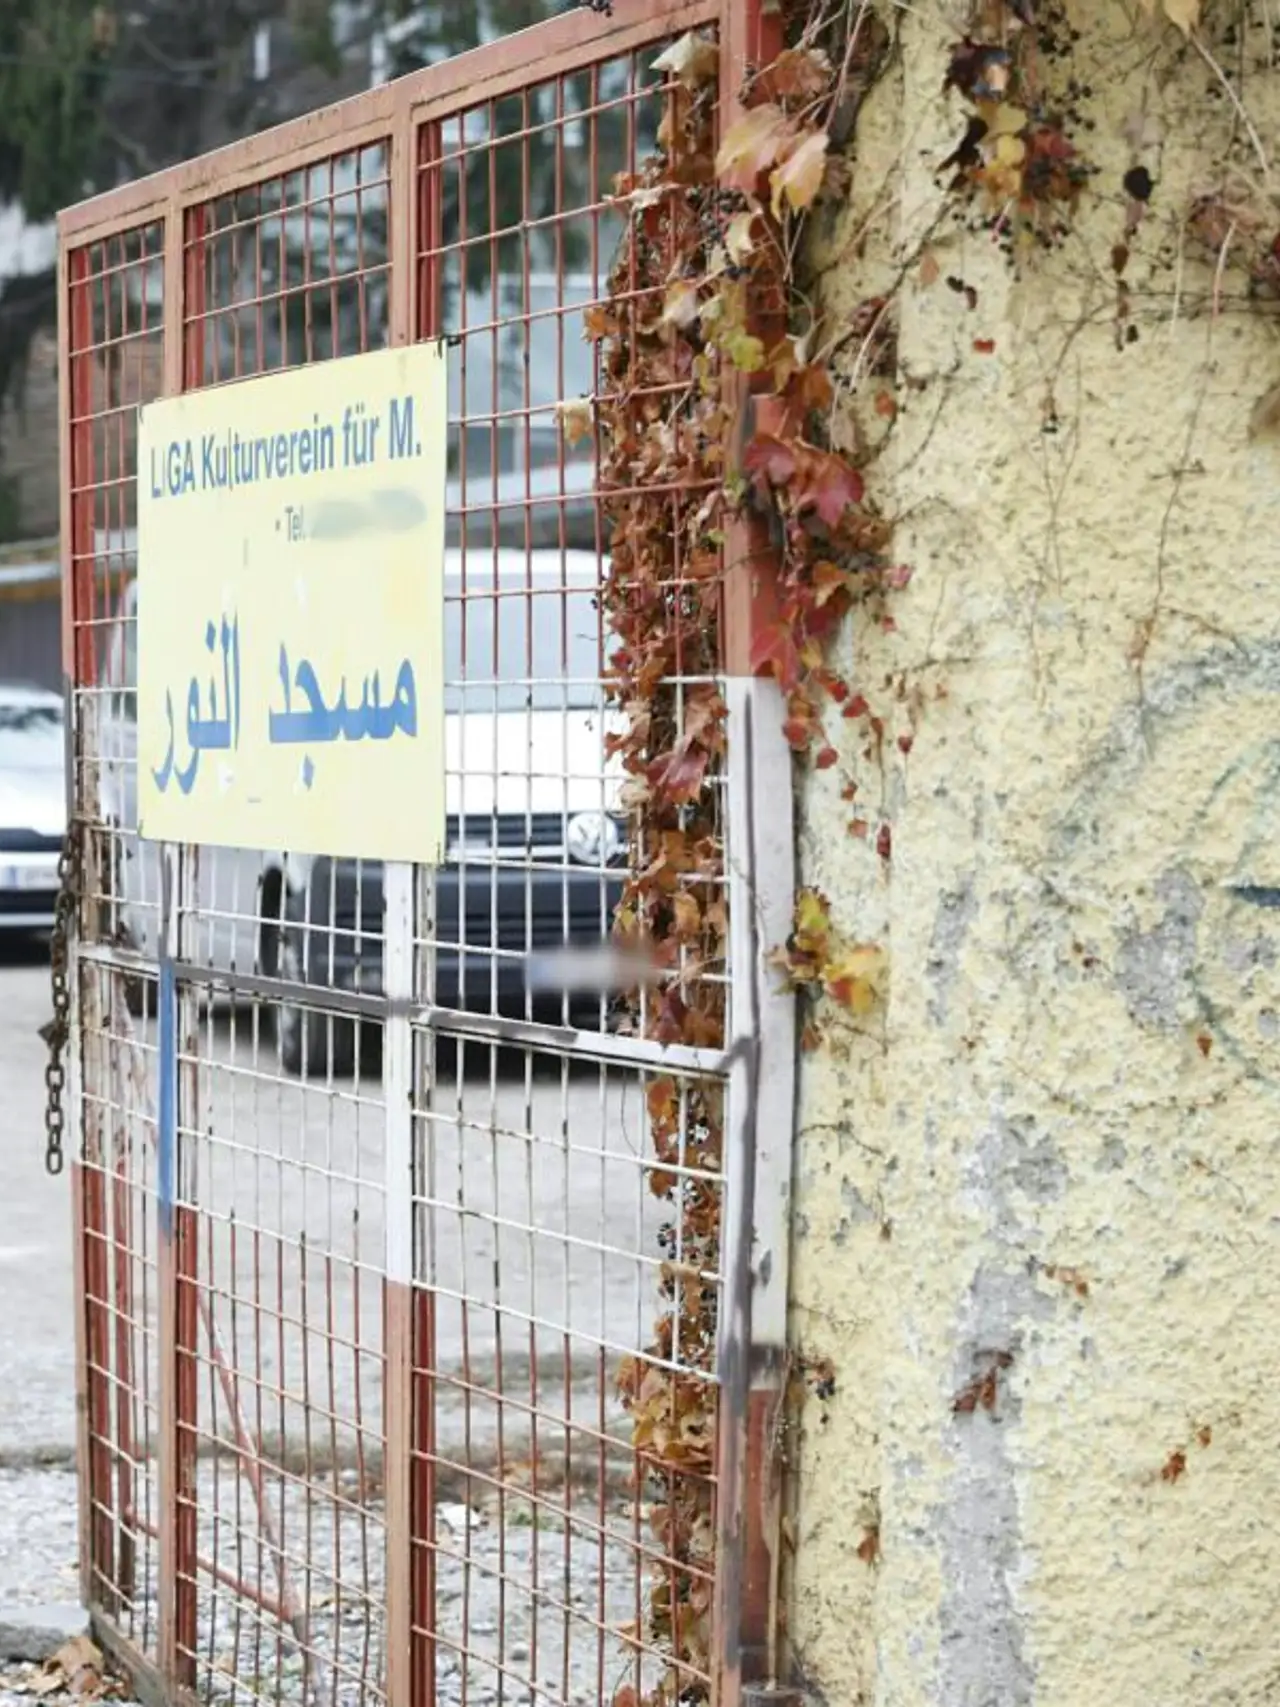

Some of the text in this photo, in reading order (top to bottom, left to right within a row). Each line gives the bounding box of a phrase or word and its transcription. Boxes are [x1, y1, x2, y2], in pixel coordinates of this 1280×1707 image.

[151, 395, 422, 499] LIGA Kulturverein für M.
[150, 605, 417, 796] مسجد النور
